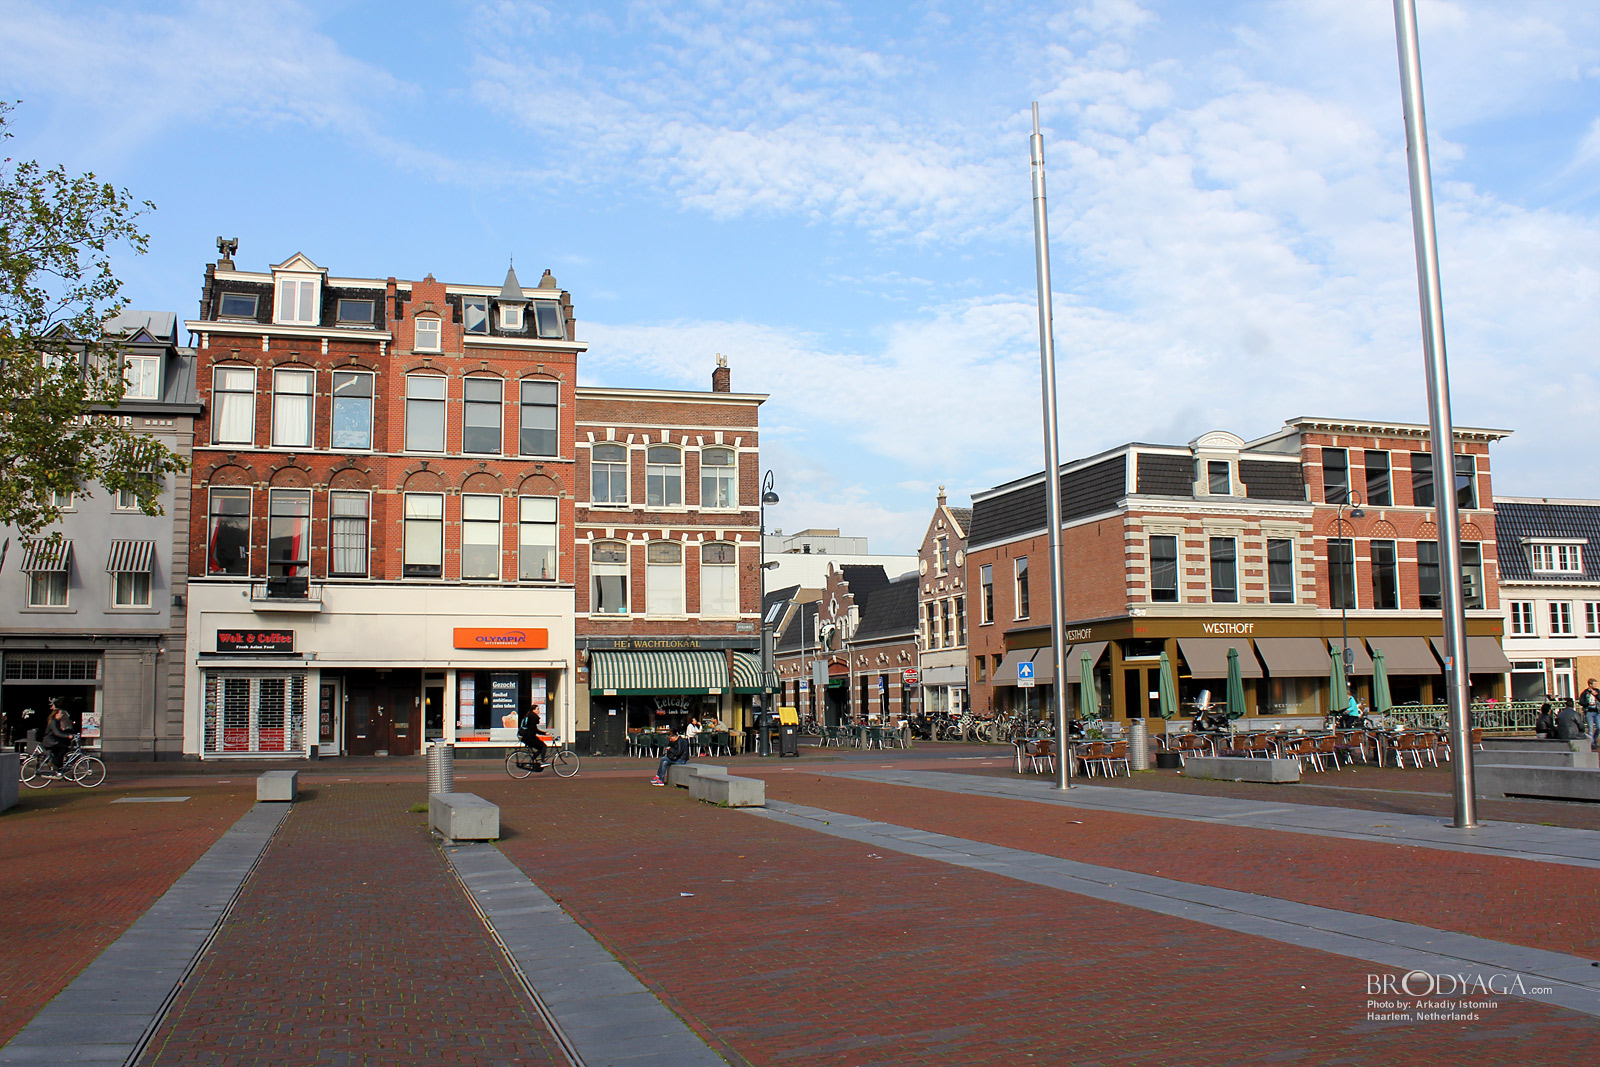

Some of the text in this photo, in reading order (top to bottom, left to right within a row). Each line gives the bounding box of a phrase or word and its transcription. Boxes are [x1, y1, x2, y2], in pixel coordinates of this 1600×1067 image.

[1202, 622, 1255, 634] WESTHOFF
[218, 632, 292, 643] Wok & Coffee
[633, 640, 701, 648] WACHTLOKAAL
[492, 681, 516, 689] Gezocht
